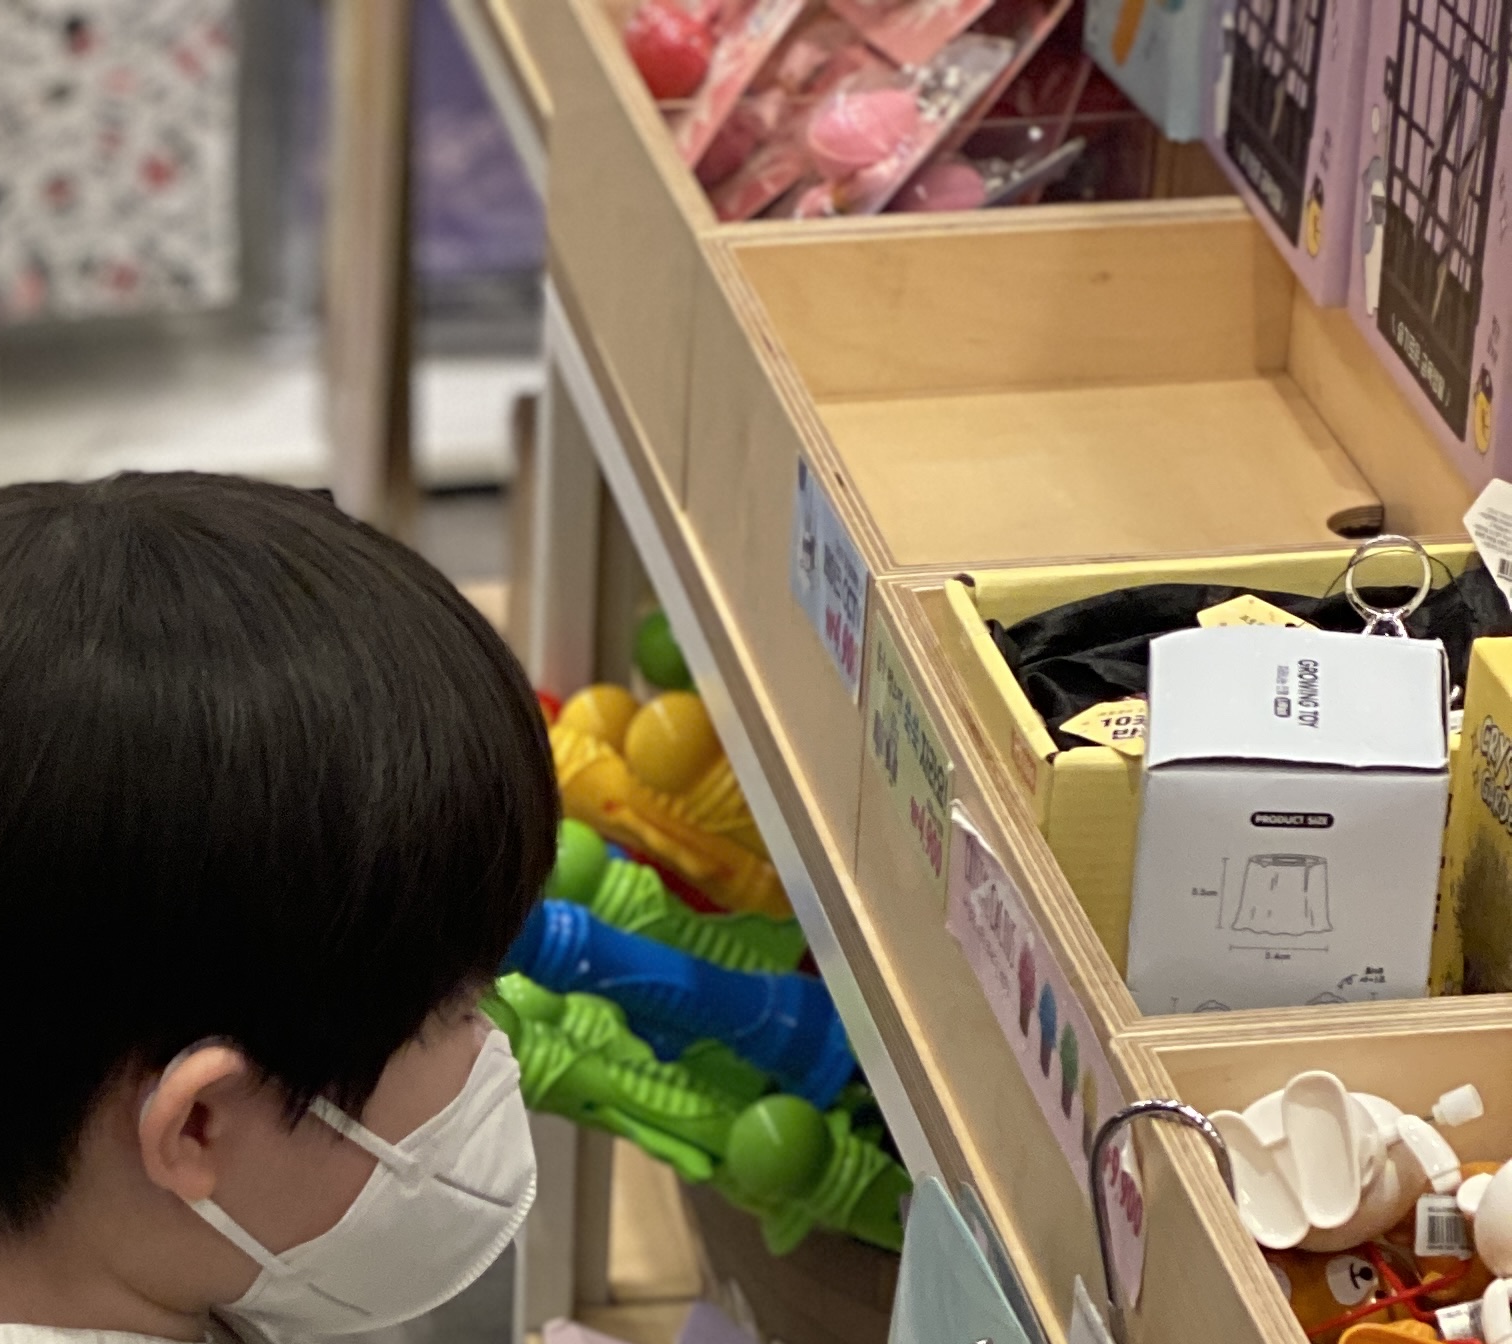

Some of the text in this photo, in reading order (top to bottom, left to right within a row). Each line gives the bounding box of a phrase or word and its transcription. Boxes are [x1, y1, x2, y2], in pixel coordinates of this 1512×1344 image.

[1298, 658, 1319, 728] GROWING TOY
[1254, 813, 1329, 826] PRODUCT SIZE
